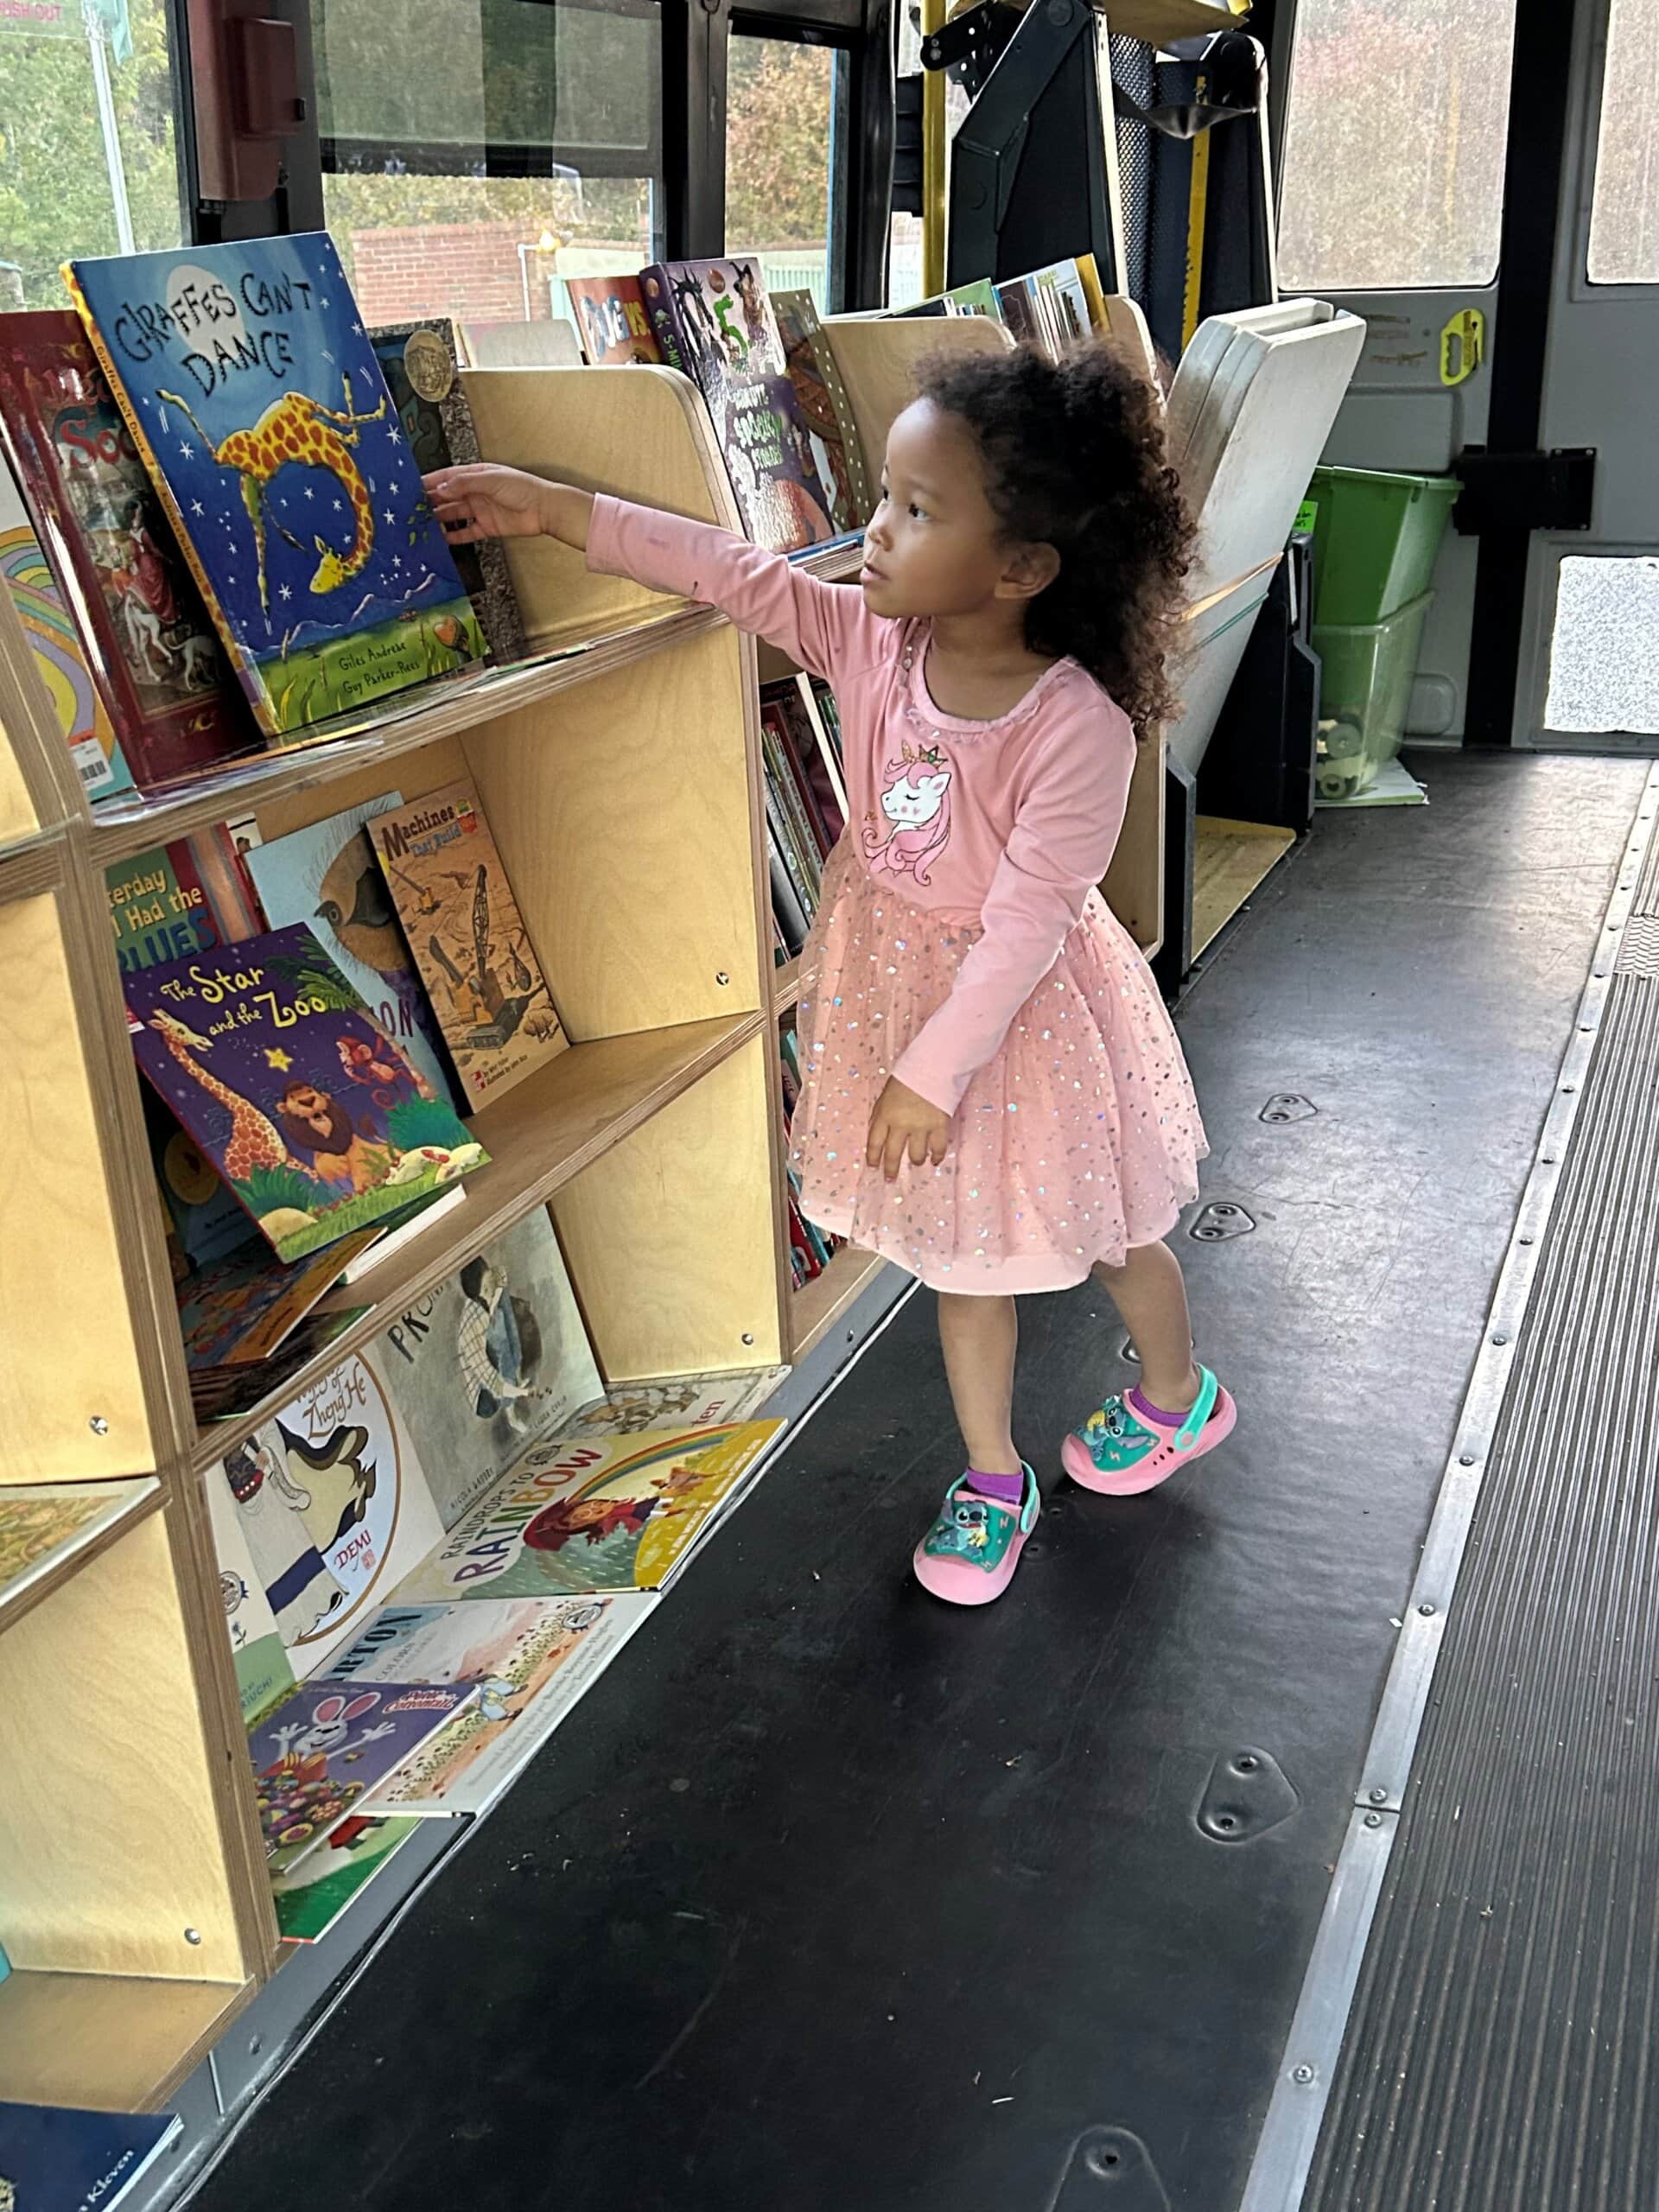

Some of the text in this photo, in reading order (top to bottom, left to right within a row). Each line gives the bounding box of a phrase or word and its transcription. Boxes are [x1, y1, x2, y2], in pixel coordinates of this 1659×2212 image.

[115, 272, 311, 362] GIRAFFES CAN'T
[181, 331, 295, 397] DANCE
[339, 642, 407, 671] Giles Andreae
[342, 661, 420, 696] Guy Parker-Rees
[381, 806, 454, 861] Machines
[124, 898, 167, 932] Had
[168, 887, 203, 912] the
[160, 965, 264, 1003] The Star
[209, 991, 327, 1035] and the Zoo
[302, 1391, 346, 1440] Zheng
[345, 1362, 366, 1409] He
[441, 1472, 534, 1560] RAINDROPS TO
[454, 1448, 602, 1582] RAINBOW
[334, 1529, 372, 1572] DEMI
